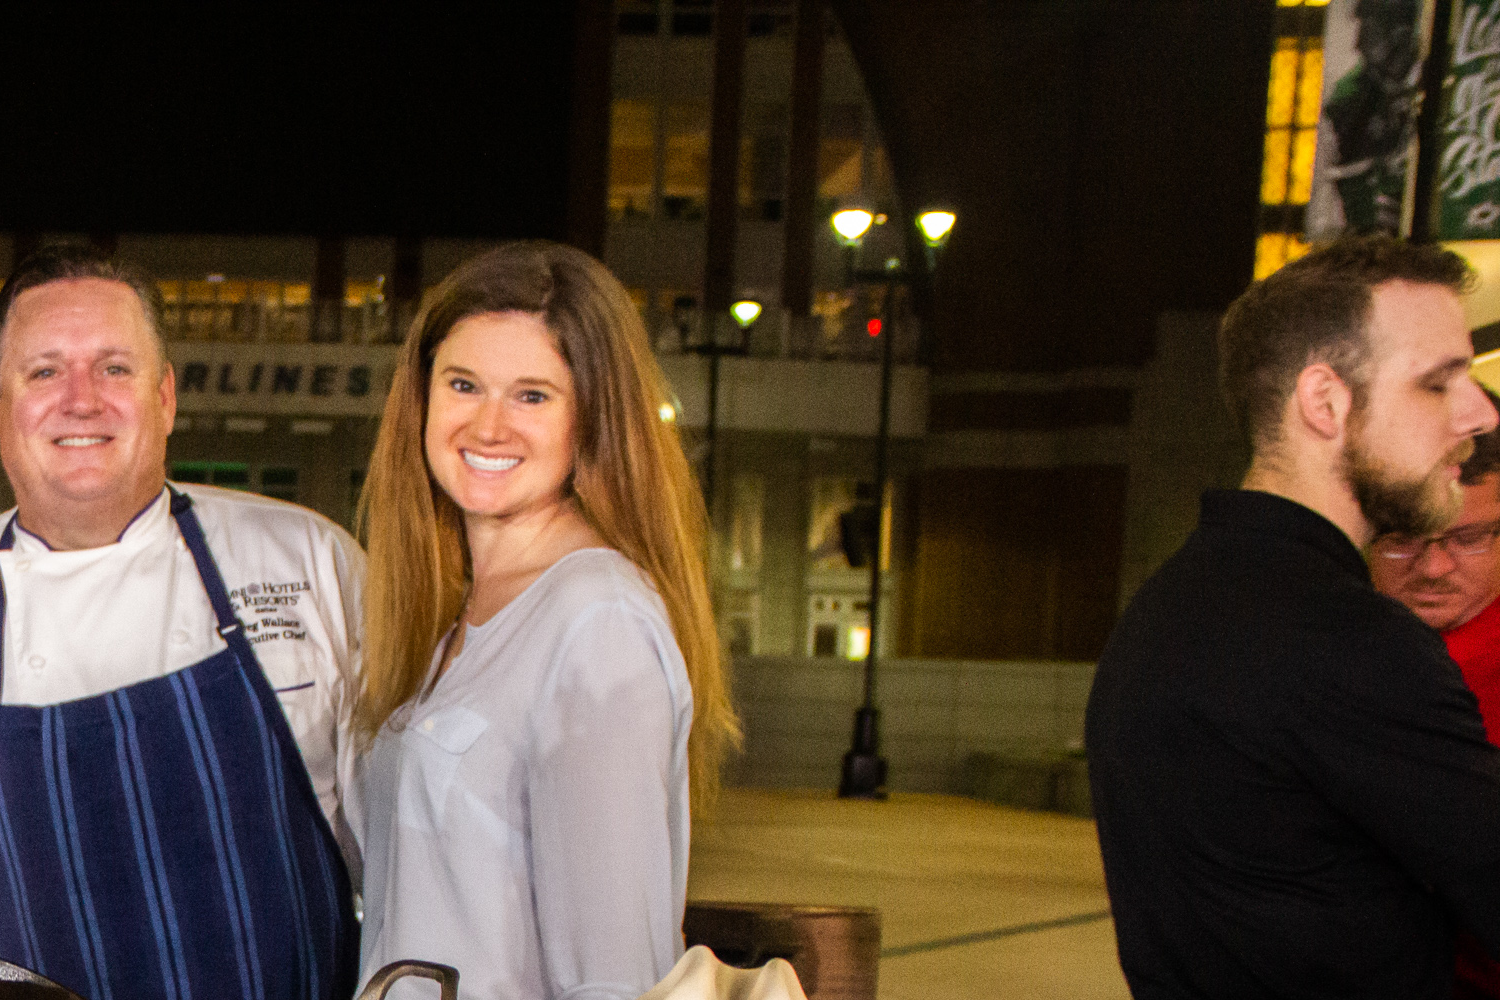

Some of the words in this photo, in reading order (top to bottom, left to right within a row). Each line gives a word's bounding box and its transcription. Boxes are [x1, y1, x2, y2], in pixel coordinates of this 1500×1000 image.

[178, 361, 372, 397] RLINES
[261, 581, 311, 594] HOTELS
[261, 618, 301, 628] Wallace
[249, 631, 280, 643] cutive
[282, 630, 307, 641] Chef
